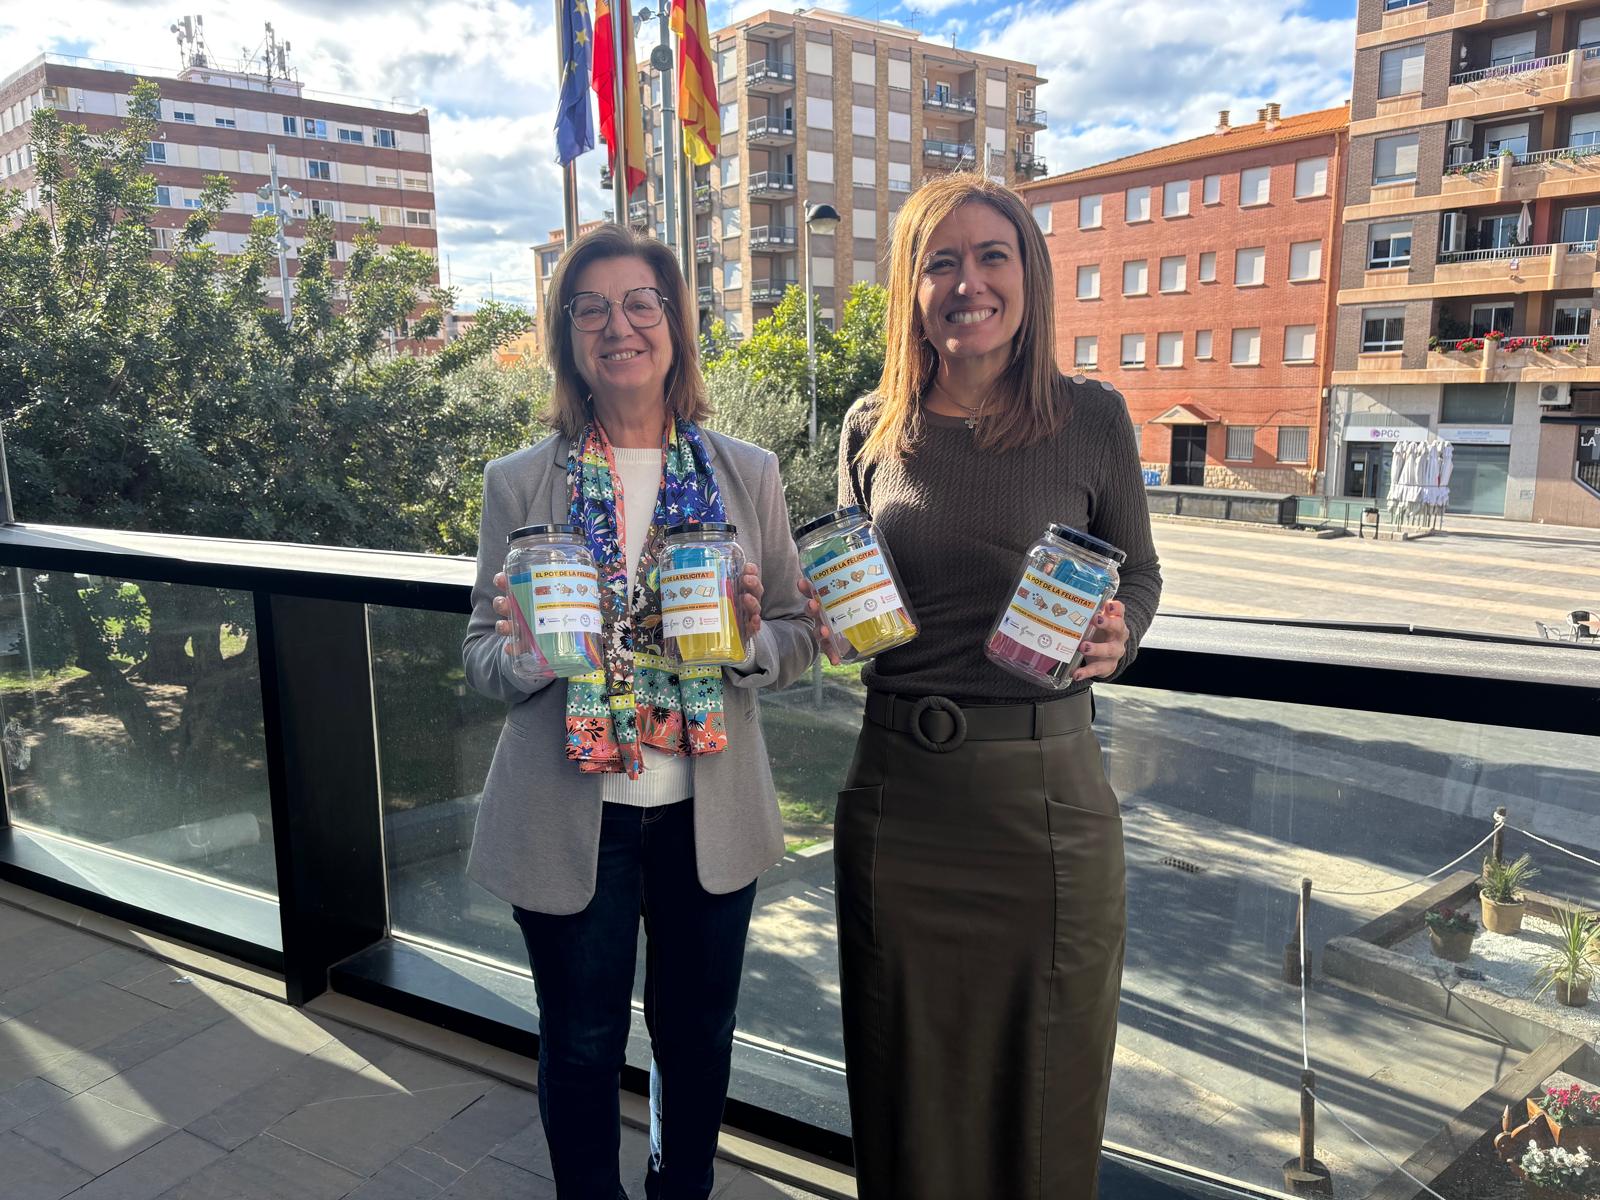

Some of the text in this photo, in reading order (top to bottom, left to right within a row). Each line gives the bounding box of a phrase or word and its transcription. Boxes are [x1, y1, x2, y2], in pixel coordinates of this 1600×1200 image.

[1381, 429, 1400, 438] PGC
[1580, 436, 1597, 447] LA
[819, 569, 829, 578] POT
[847, 550, 874, 565] FELICITAT
[680, 572, 710, 580] FELICITAT
[1031, 576, 1043, 586] POT
[1042, 582, 1052, 591] DE
[1052, 586, 1061, 594] LA
[1060, 590, 1091, 607] FELICITAT
